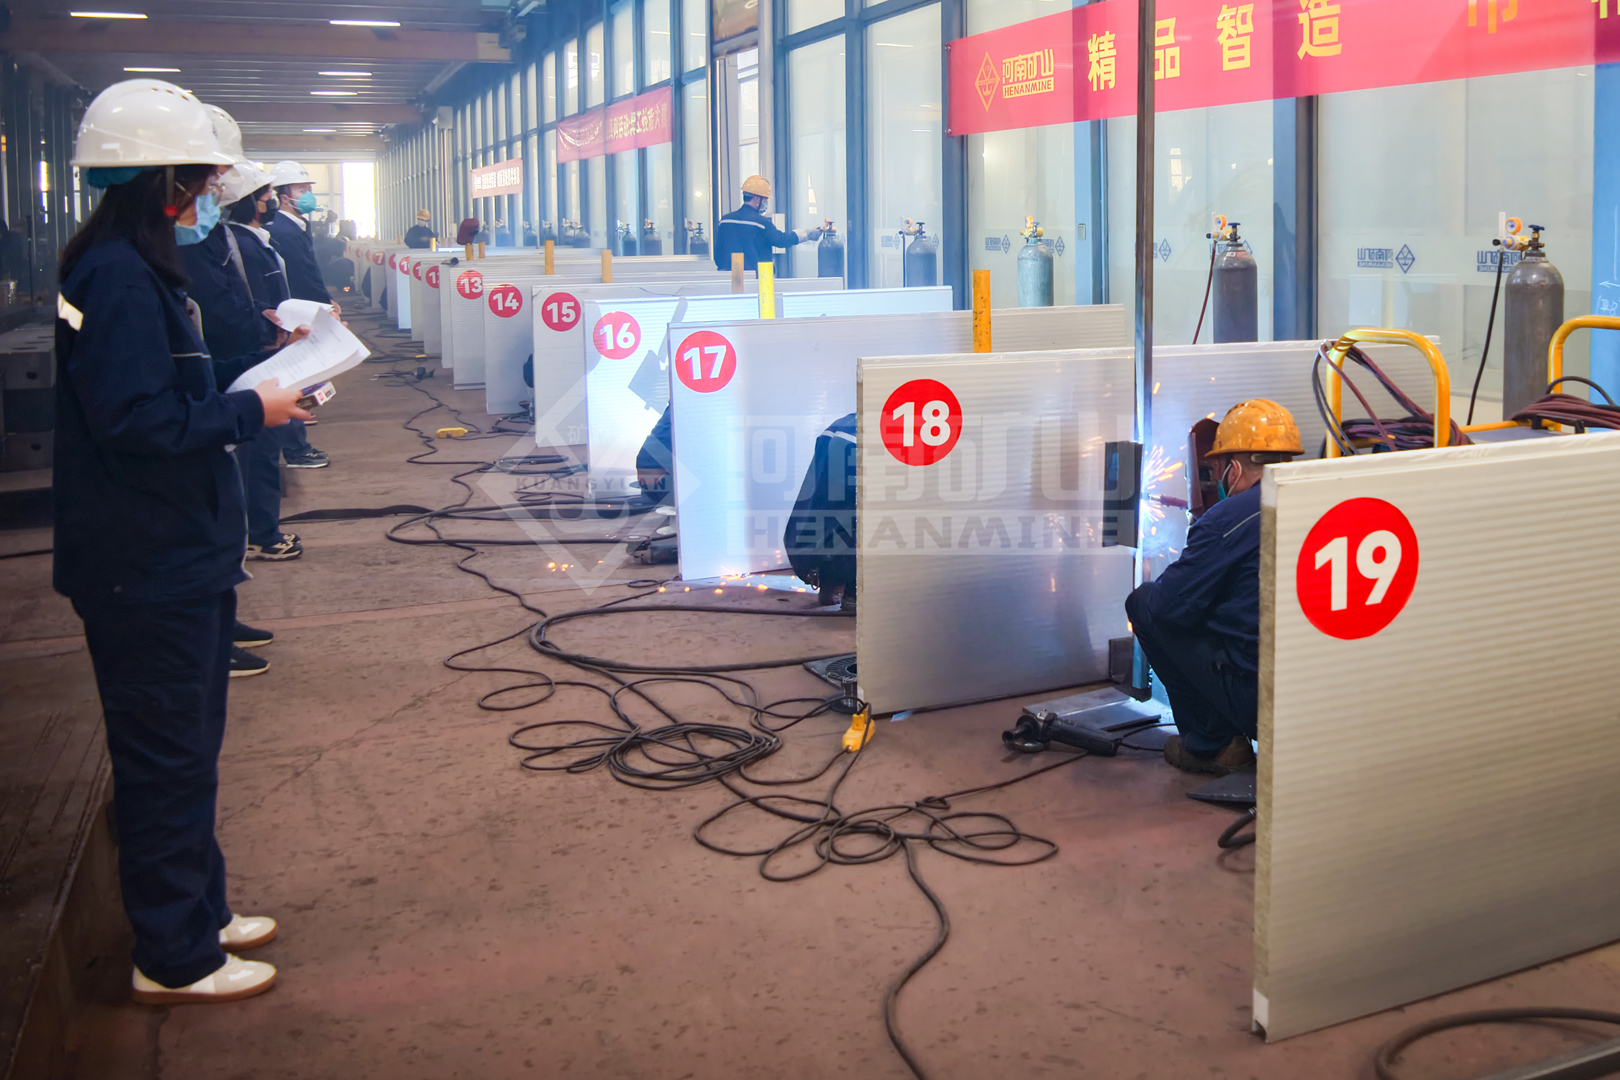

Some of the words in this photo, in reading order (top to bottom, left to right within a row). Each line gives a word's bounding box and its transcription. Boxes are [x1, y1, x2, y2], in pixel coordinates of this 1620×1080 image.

[1003, 48, 1054, 84] 河南矿山
[1004, 79, 1053, 97] HENANMINE
[375, 252, 384, 264] 7
[460, 277, 483, 294] 13
[492, 292, 519, 311] 14
[546, 301, 576, 323] 15
[600, 322, 636, 350] 16
[683, 345, 727, 380] 17
[892, 400, 951, 447] 18
[1314, 529, 1402, 612] 19
